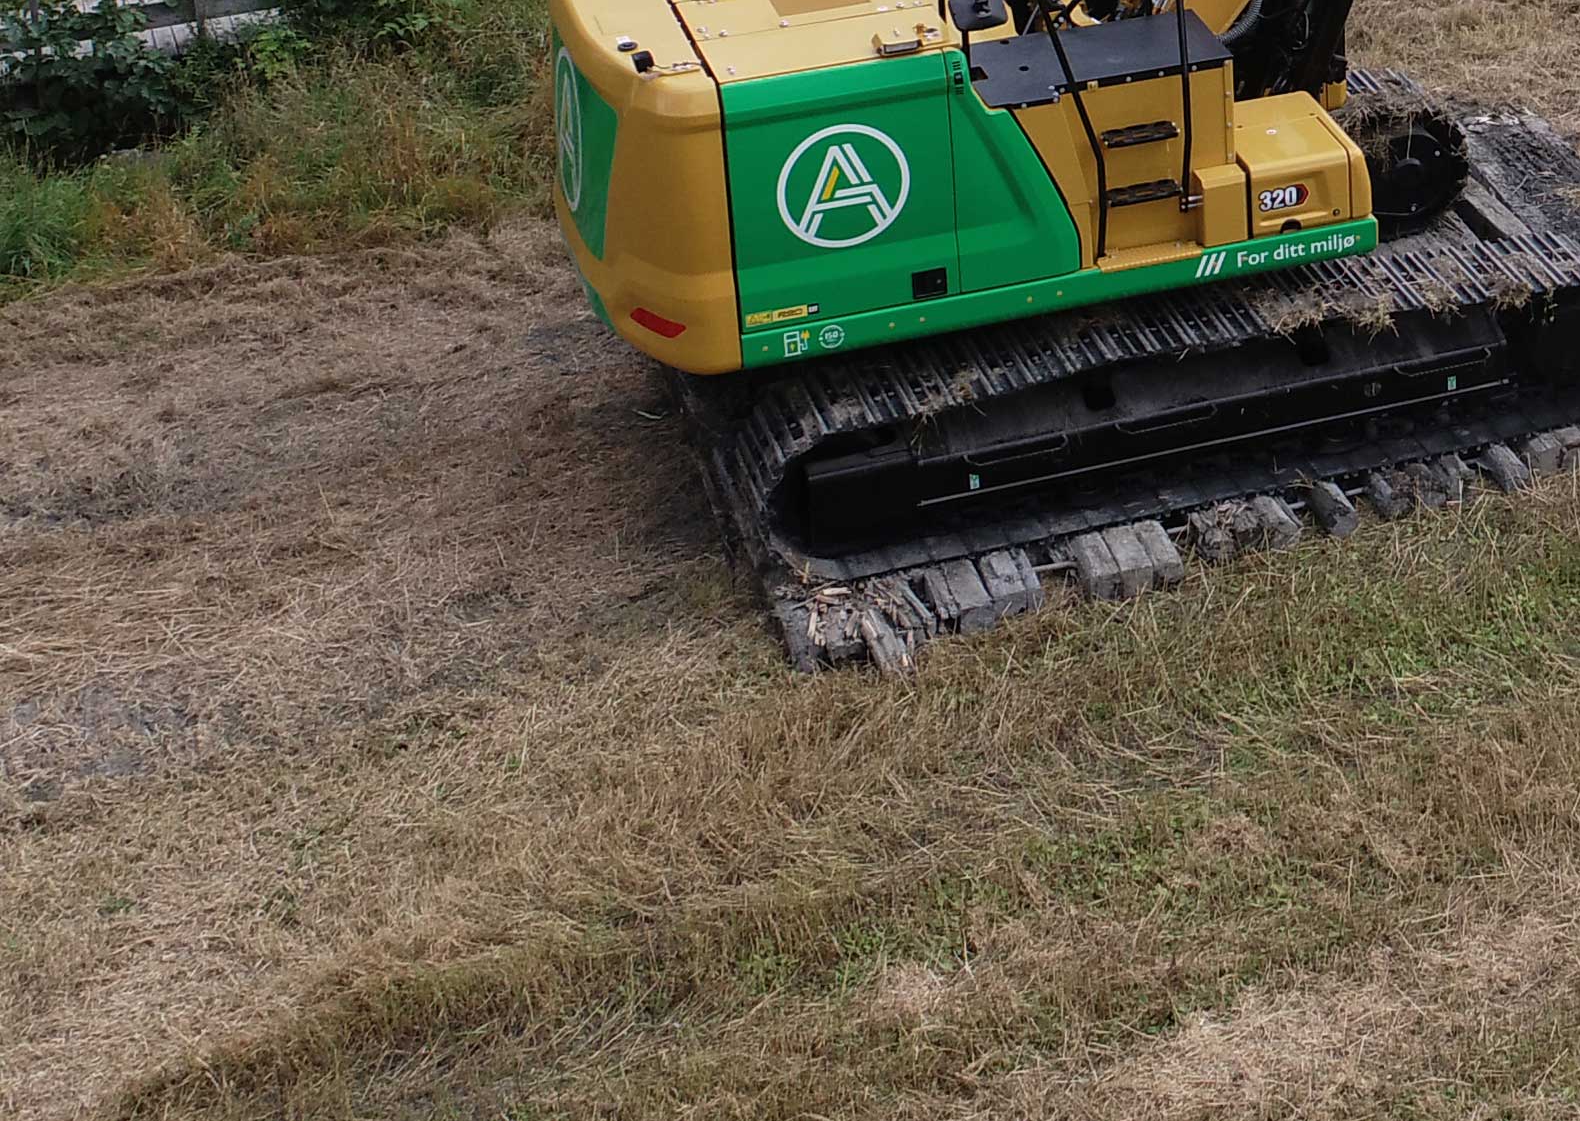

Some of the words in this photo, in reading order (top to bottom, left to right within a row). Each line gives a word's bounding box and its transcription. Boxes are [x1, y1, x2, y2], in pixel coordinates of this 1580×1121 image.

[1258, 184, 1299, 212] 320
[1236, 250, 1270, 269] For
[1273, 243, 1306, 261] ditt
[1310, 233, 1356, 255] miljø
